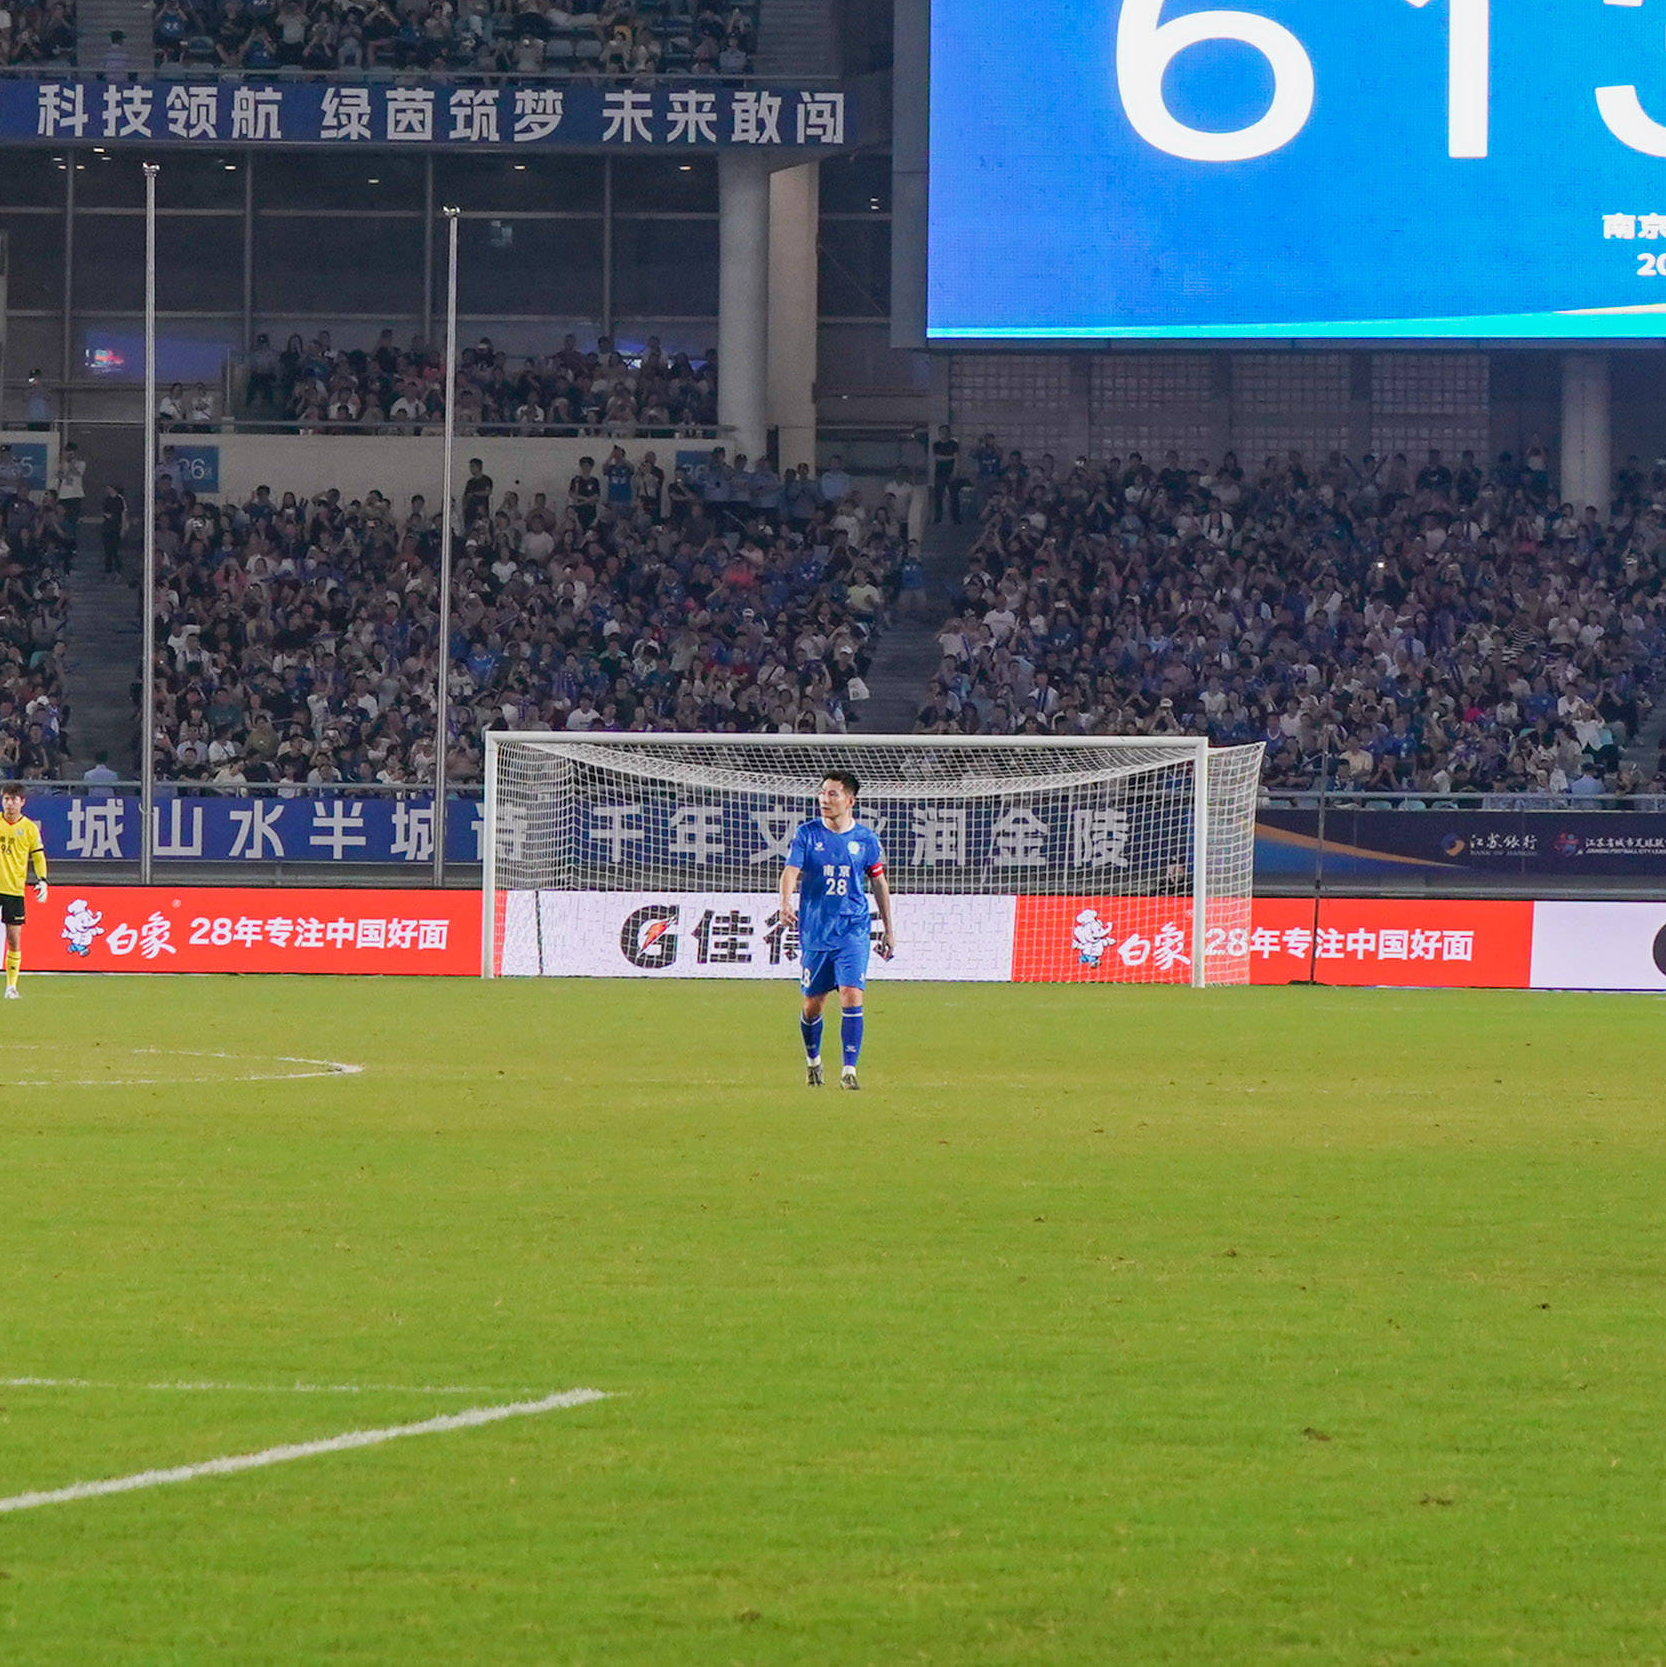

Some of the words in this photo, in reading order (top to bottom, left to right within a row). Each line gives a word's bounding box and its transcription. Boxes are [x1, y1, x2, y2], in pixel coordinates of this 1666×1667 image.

[38, 84, 282, 139] 科技领航
[320, 88, 564, 142] 绿茵筑梦
[602, 90, 845, 144] 未来敢闯
[35, 798, 529, 863] 城山水半城诗
[822, 865, 850, 878] 南京
[825, 878, 848, 896] 28
[106, 911, 177, 959] 白象
[188, 917, 450, 951] 28年专注中国好面
[1117, 922, 1191, 971] 白象
[1204, 927, 1474, 962] 28年专注中国好面
